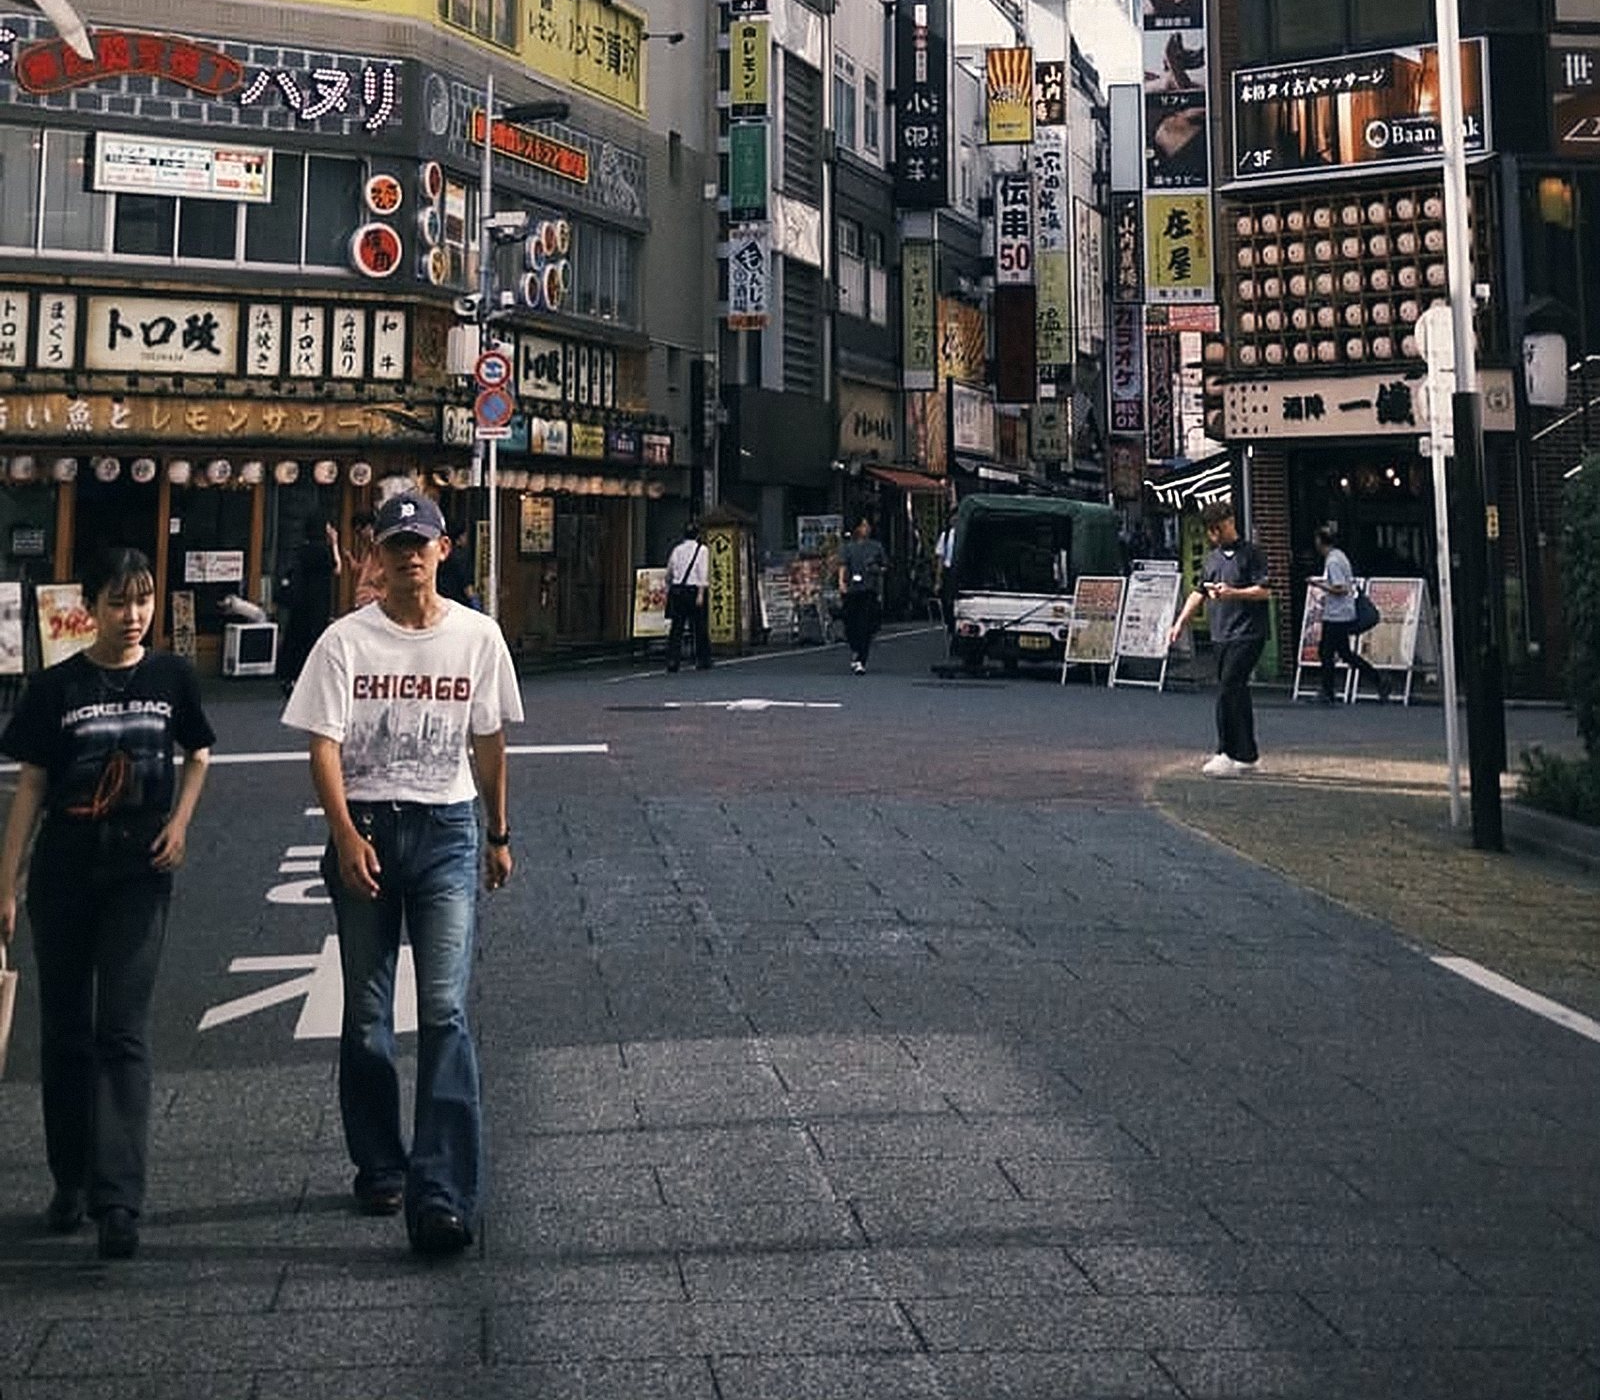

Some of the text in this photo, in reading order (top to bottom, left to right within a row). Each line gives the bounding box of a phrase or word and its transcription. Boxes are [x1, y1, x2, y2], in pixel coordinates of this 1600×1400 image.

[241, 67, 395, 131] ハヌリ
[1240, 68, 1385, 102] 本格タイ古式マッサージ
[1392, 125, 1436, 144] Baan
[1000, 174, 1030, 239] 伝串
[1000, 244, 1030, 271] 50
[1163, 207, 1192, 282] 庄屋
[48, 301, 65, 362] まぐろ
[108, 309, 221, 355] トロ政
[380, 316, 398, 371] 和牛
[353, 674, 471, 702] CHICAGO
